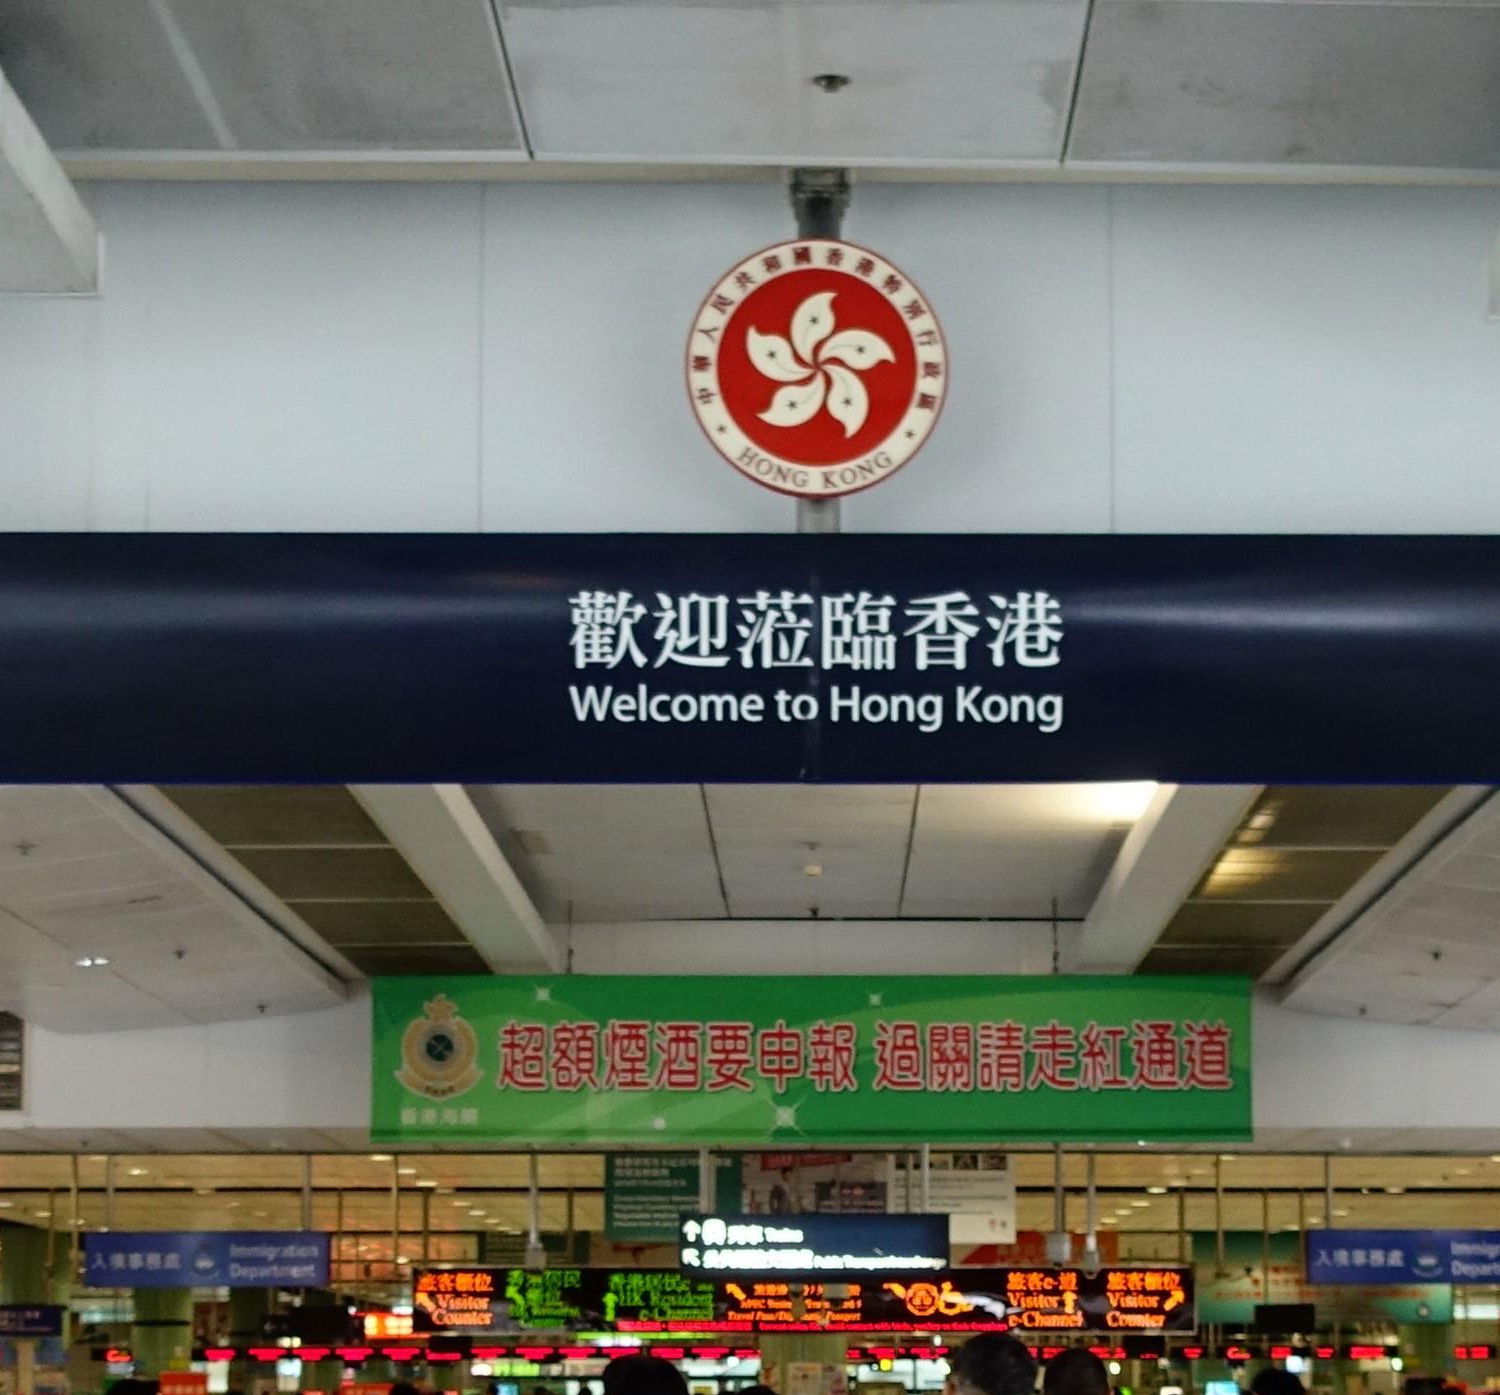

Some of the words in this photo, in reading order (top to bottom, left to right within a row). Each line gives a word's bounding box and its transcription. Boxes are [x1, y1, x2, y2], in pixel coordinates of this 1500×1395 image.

[736, 447, 809, 488] HONG
[821, 451, 894, 489] KONG
[568, 684, 765, 723] Welcome
[774, 689, 819, 723] to
[831, 685, 944, 733] Hong
[956, 685, 1064, 733] Kong
[498, 1018, 858, 1093] 超額煙酒要申報
[873, 1018, 1235, 1093] 過關請走紅通道
[229, 1244, 320, 1262] Immigration
[229, 1263, 316, 1280] Department
[1006, 1291, 1061, 1309] Visitor
[1106, 1291, 1161, 1309] Visitor
[1105, 1310, 1167, 1328] Counter
